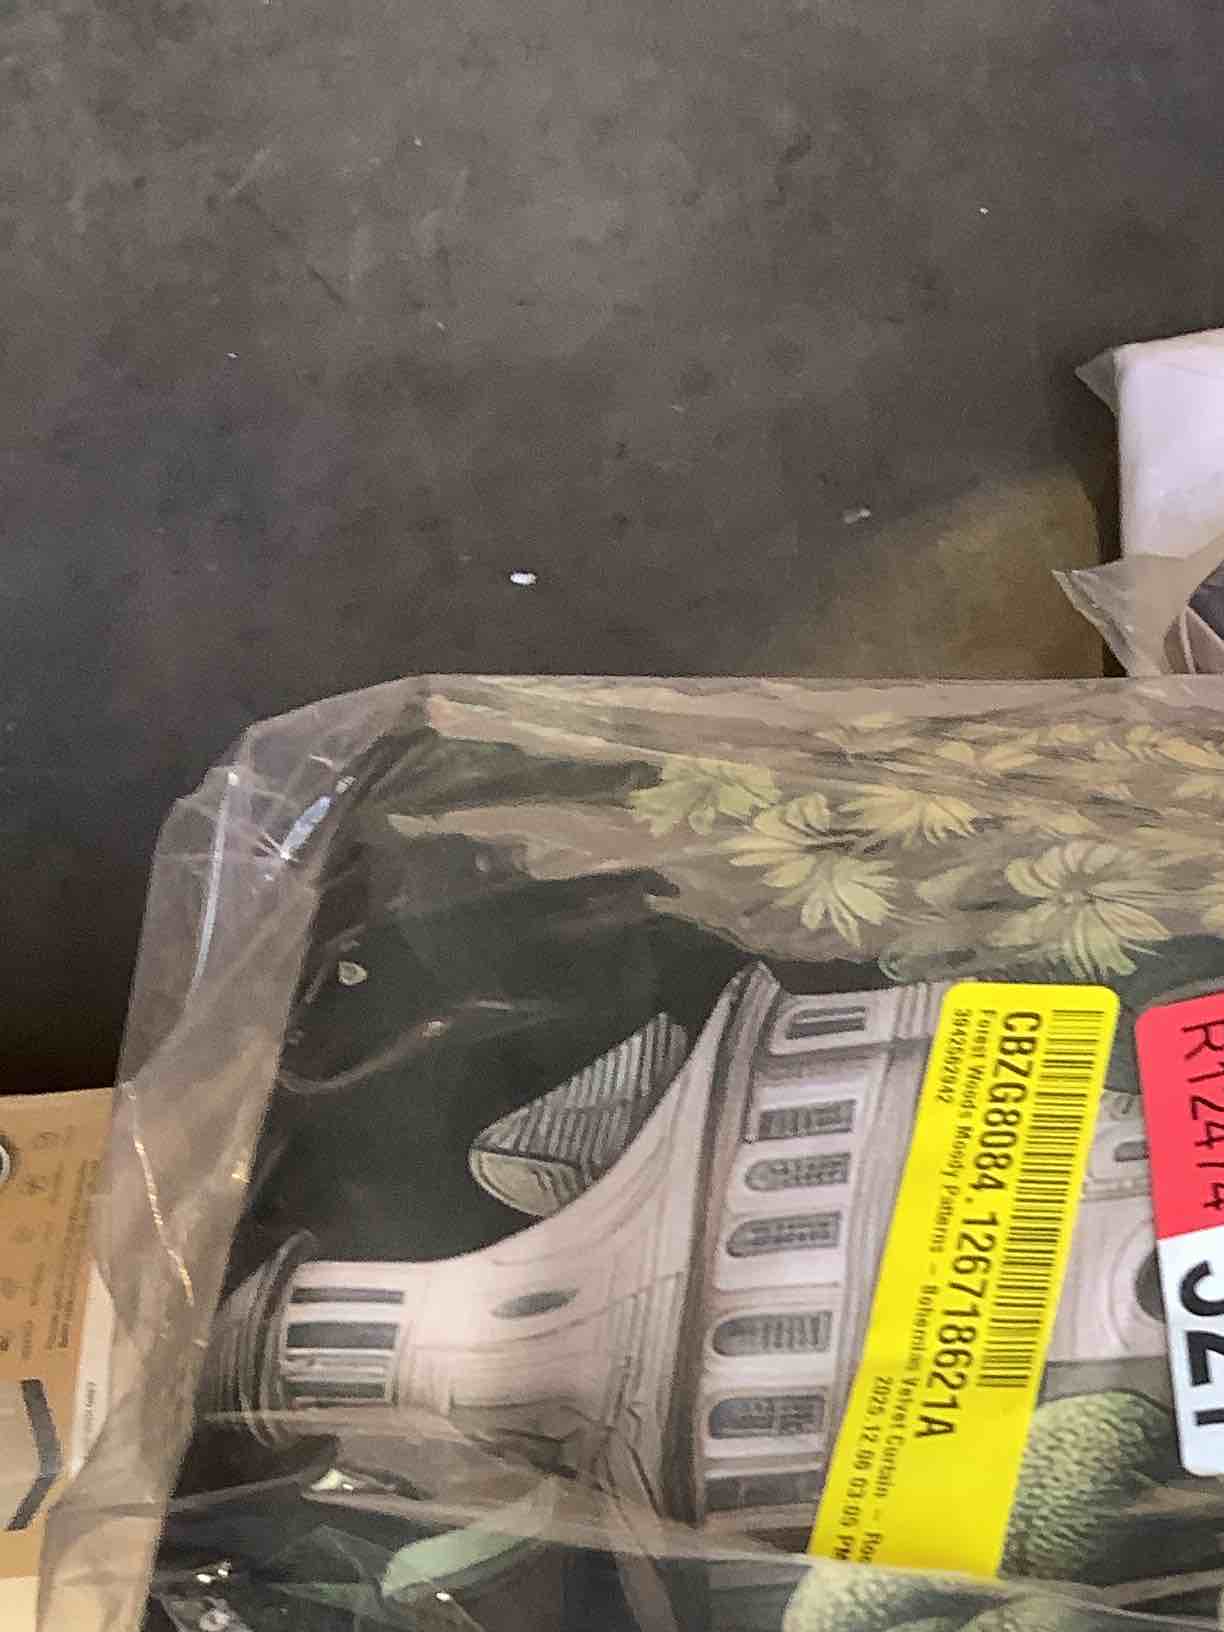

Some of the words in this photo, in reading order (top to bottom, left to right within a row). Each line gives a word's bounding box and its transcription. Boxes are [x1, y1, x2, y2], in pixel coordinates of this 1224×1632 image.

[971, 1008, 998, 1062] Forest
[960, 1063, 984, 1119] Woods
[941, 1125, 975, 1178] Moody
[913, 1009, 1043, 1438] CBZG8084.126718621A
[928, 1185, 961, 1254] Patterns
[889, 1377, 921, 1430] Velvet
[873, 1434, 905, 1500] Curtain
